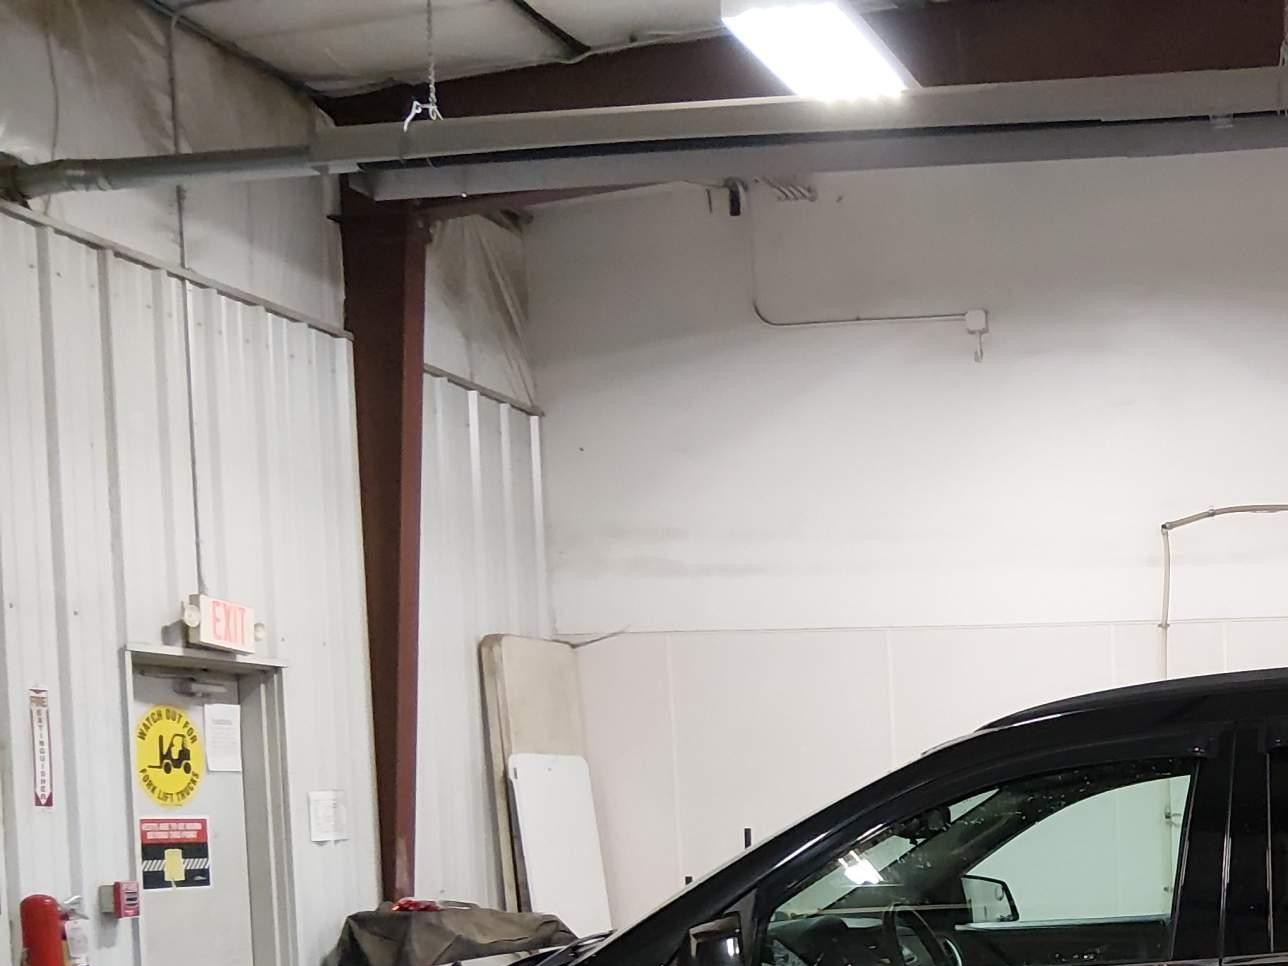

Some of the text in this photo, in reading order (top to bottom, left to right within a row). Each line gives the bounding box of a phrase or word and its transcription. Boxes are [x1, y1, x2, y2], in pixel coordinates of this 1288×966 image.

[212, 600, 246, 646] EXIT
[137, 709, 163, 741] WATCH
[165, 708, 183, 724] OUT
[183, 720, 197, 744] FOR
[139, 768, 200, 803] FORK LIFT TRUCKS
